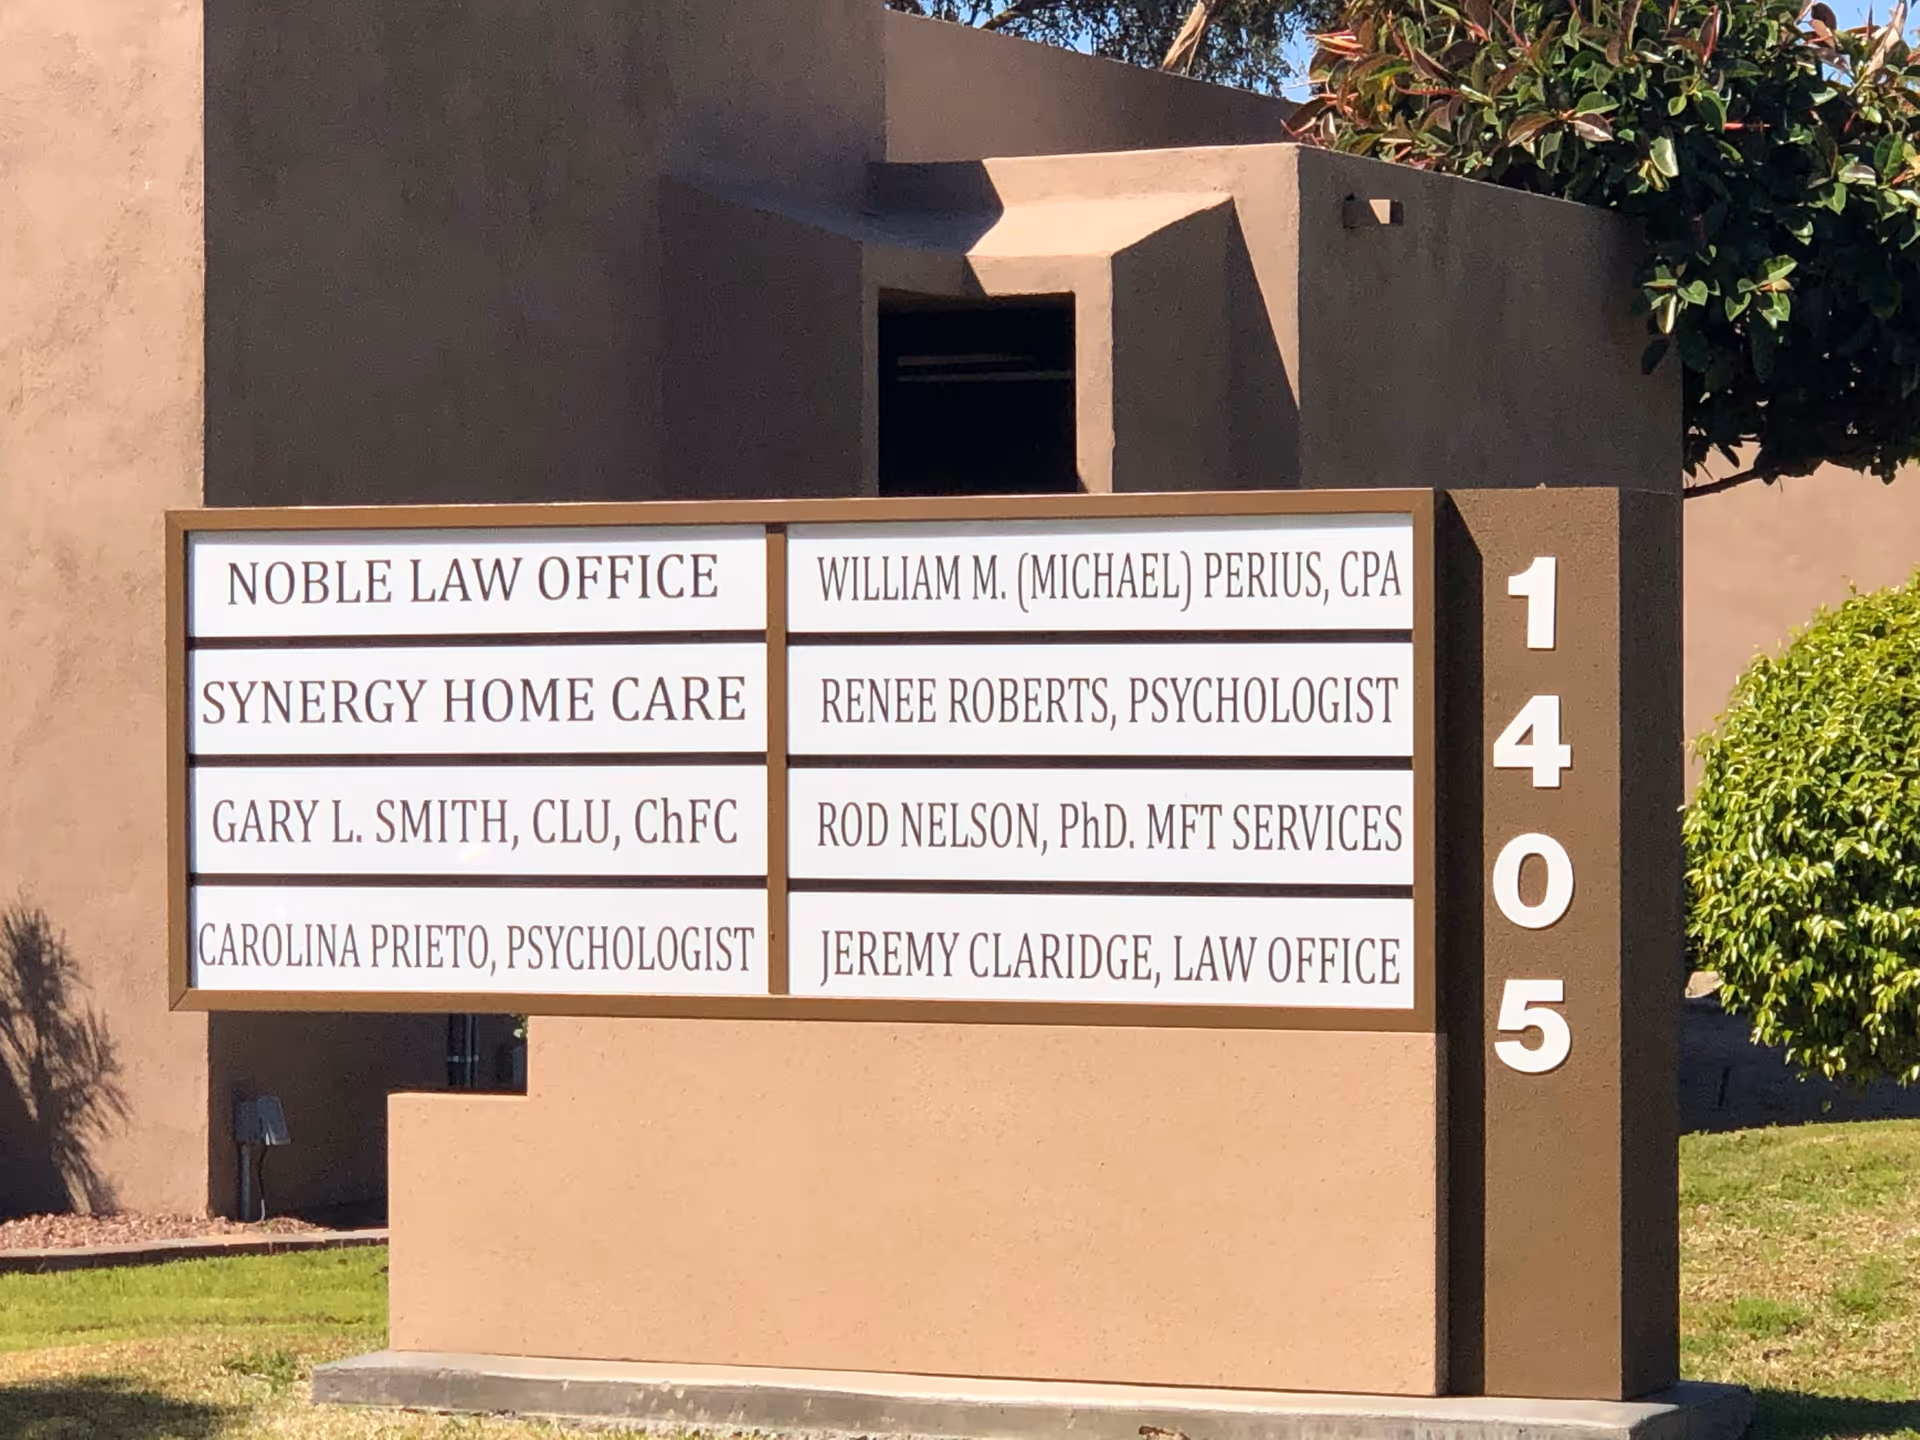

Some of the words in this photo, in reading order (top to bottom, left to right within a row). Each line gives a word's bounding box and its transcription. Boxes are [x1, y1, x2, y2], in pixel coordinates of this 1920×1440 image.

[229, 559, 392, 606] NOBLE
[410, 556, 523, 603] LAW
[537, 553, 718, 601] OFFICE
[817, 554, 961, 602] WILLIAM
[972, 554, 1007, 601] M.
[1017, 551, 1191, 613] (MICHAEL)
[1204, 550, 1329, 606] PERIUS,
[1339, 549, 1402, 598] CPA
[202, 679, 427, 724] SYNERGY
[443, 677, 595, 723] HOME
[611, 675, 747, 722] CARE
[820, 677, 937, 724] RENEE
[948, 677, 1117, 731] ROBERTS,
[1128, 676, 1399, 724] PSYCHOLOGIST
[212, 798, 320, 843] GARY
[331, 799, 363, 843] L.
[375, 798, 519, 851] SMITH,
[532, 798, 621, 852] CLU,
[634, 796, 738, 845] ChFC
[817, 801, 889, 848] ROD
[900, 801, 1048, 857] NELSON,
[1059, 800, 1135, 850] PhD.
[1146, 802, 1224, 851] MFT
[1232, 803, 1403, 853] SERVICES
[1492, 556, 1575, 1074] 1405
[198, 922, 361, 968] CAROLINA
[370, 923, 498, 976] PRIETO,
[507, 925, 756, 972] PSYCHOLOGIST
[819, 929, 961, 987] JEREMY
[968, 932, 1161, 989] CLARIDGE,
[1173, 935, 1259, 983] LAW
[1267, 936, 1401, 986] OFFICE
